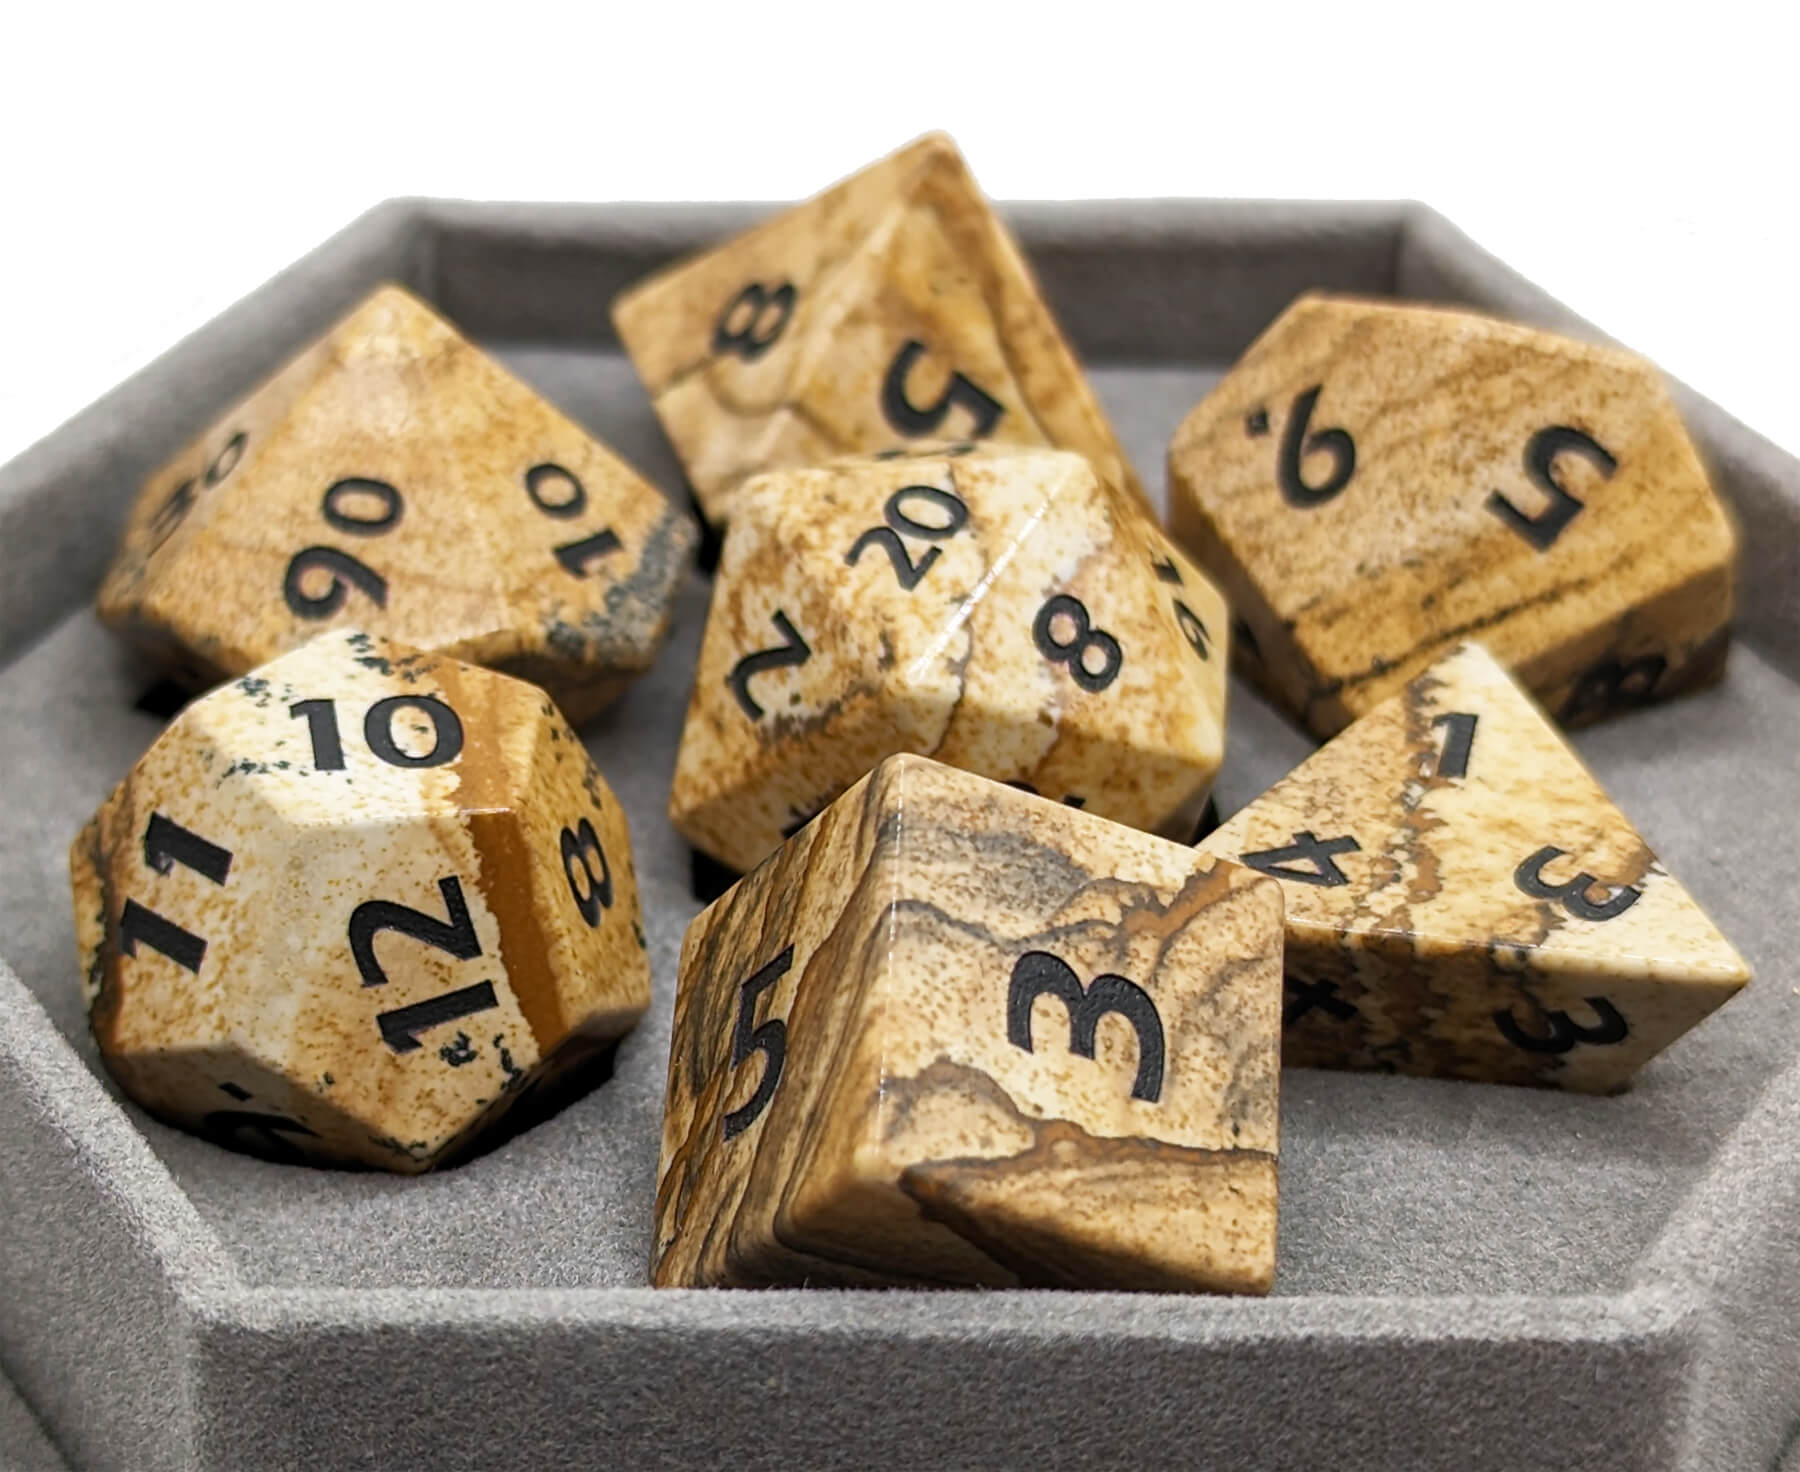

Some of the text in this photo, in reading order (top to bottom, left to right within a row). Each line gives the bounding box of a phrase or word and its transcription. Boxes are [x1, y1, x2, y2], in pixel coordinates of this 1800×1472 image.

[711, 280, 797, 364] 8
[881, 340, 1006, 438] 5
[523, 463, 622, 579] 10
[845, 485, 970, 592] 20
[1484, 425, 1618, 552] 5
[284, 477, 404, 620] 90
[1032, 593, 1122, 694] 8
[1143, 550, 1213, 662] 16
[290, 694, 464, 771] 10
[1430, 712, 1479, 778] 1
[119, 811, 233, 974] 11
[561, 817, 612, 928] 8
[1240, 830, 1362, 887] 4
[1514, 845, 1641, 922] 3
[348, 875, 500, 1054] 12
[722, 943, 795, 1142] 5
[1008, 950, 1166, 1104] 3
[1494, 997, 1627, 1054] 3
